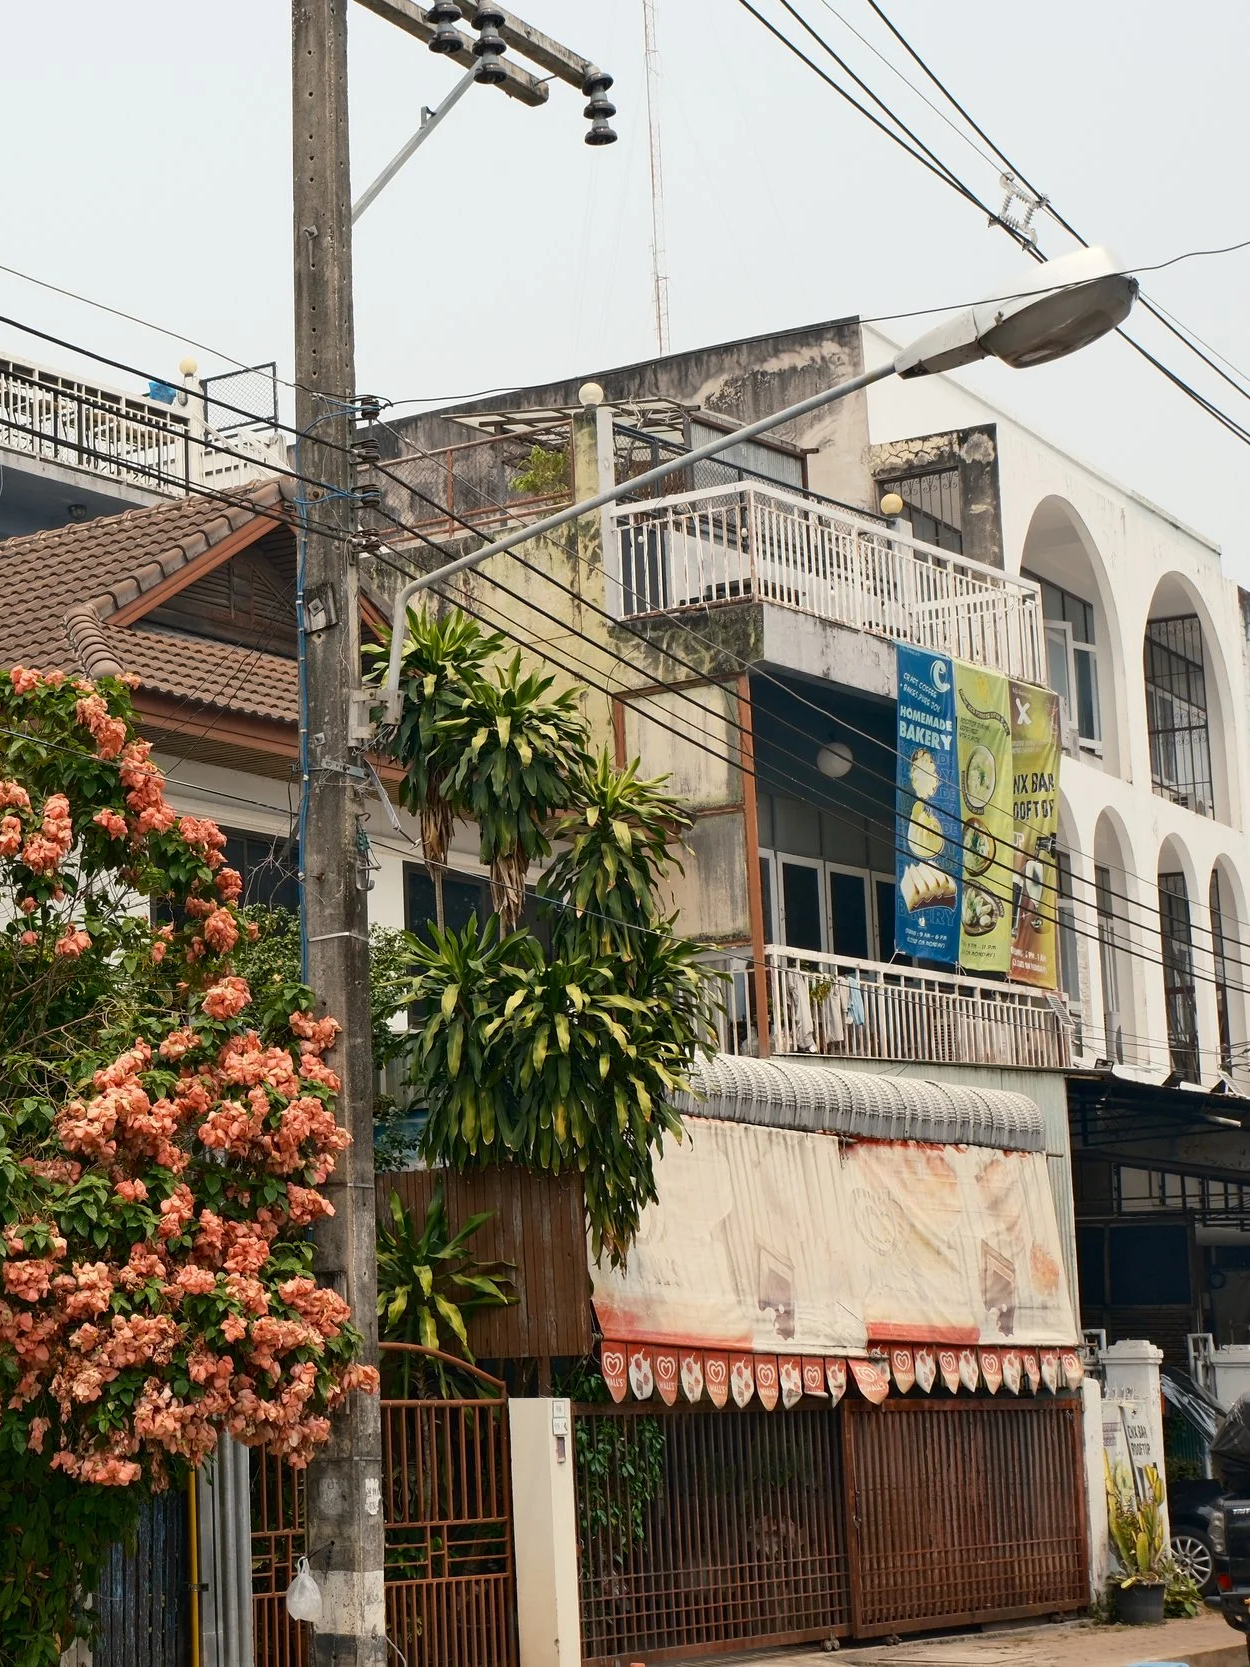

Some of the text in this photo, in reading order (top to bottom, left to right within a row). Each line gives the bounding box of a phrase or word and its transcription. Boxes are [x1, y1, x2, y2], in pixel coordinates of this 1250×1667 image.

[918, 681, 938, 699] COFFEE
[900, 705, 953, 732] HOMEMADE
[899, 720, 953, 751] BAKERY
[1012, 773, 1029, 795] NX
